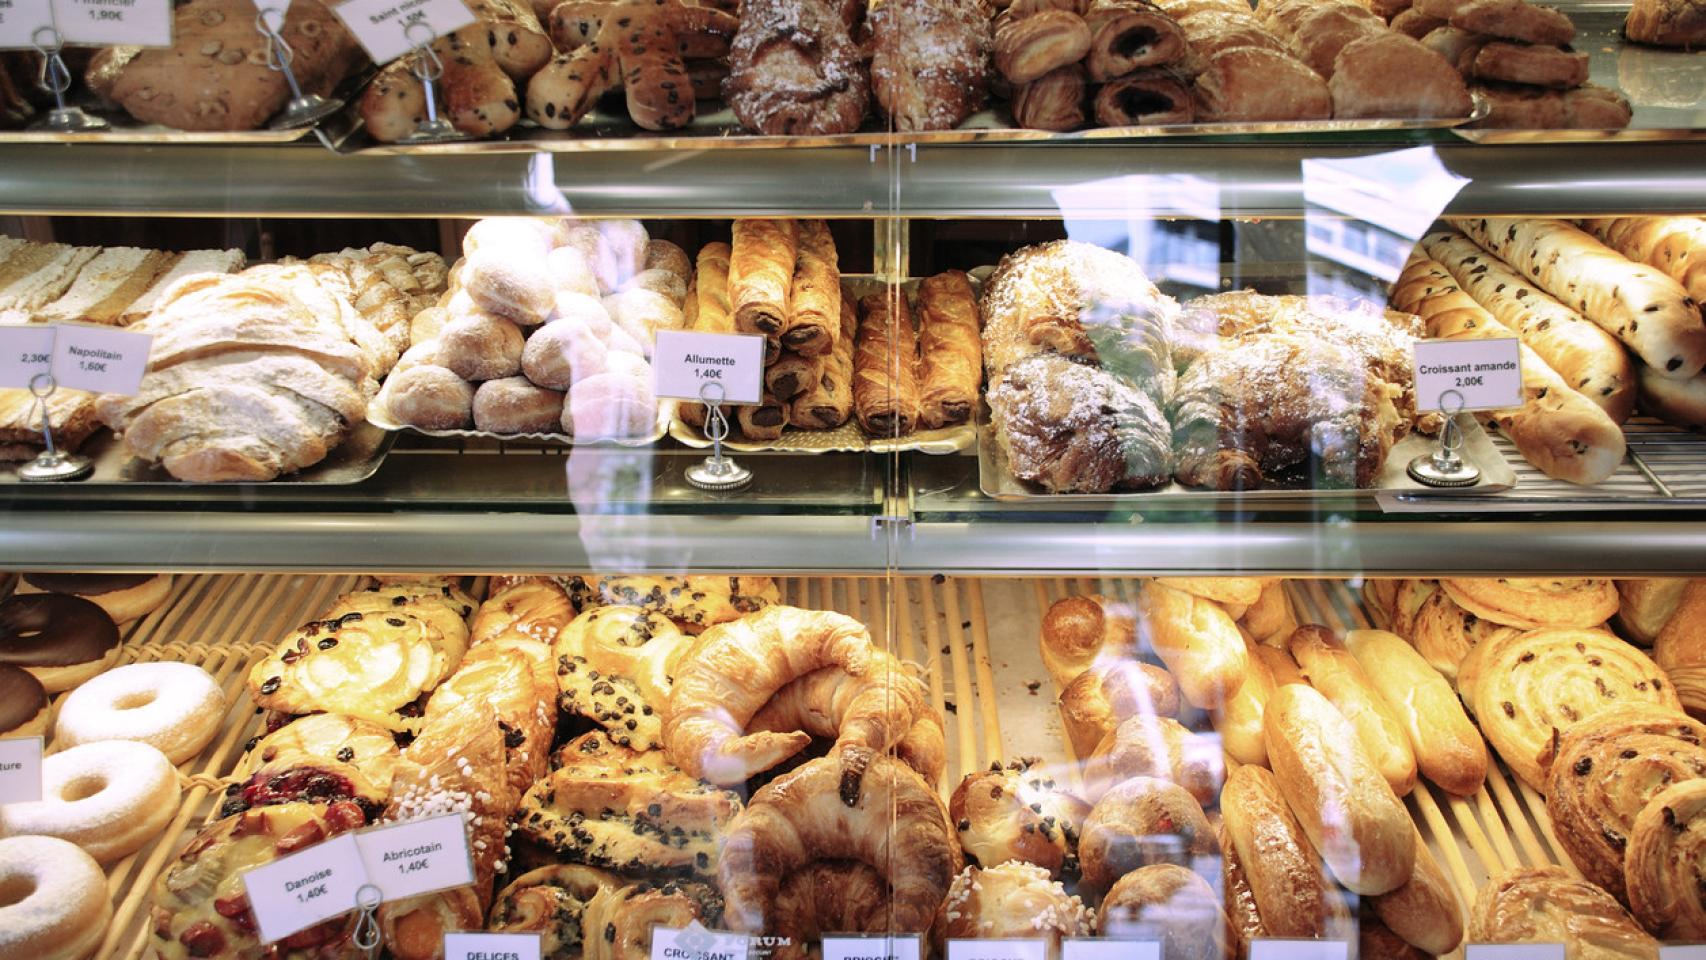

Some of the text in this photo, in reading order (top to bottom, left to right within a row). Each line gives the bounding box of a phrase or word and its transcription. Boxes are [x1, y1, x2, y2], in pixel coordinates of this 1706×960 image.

[88, 10, 123, 21] 1,90€
[369, 7, 399, 24] Saint
[21, 353, 50, 364] 2,30€
[69, 346, 122, 361] Napolitain
[684, 354, 736, 366] Allumette
[79, 361, 107, 372] 1,60€
[1419, 360, 1517, 375] Croissant amande
[694, 368, 722, 379] 1,40€
[1455, 375, 1483, 388] 2,00€
[383, 841, 442, 863] Abricotain
[398, 858, 429, 875] 1,40€
[285, 867, 333, 893] Danoise
[297, 883, 329, 903] 1,40€
[466, 951, 520, 960] DELICES
[664, 947, 736, 960] CROSSANT
